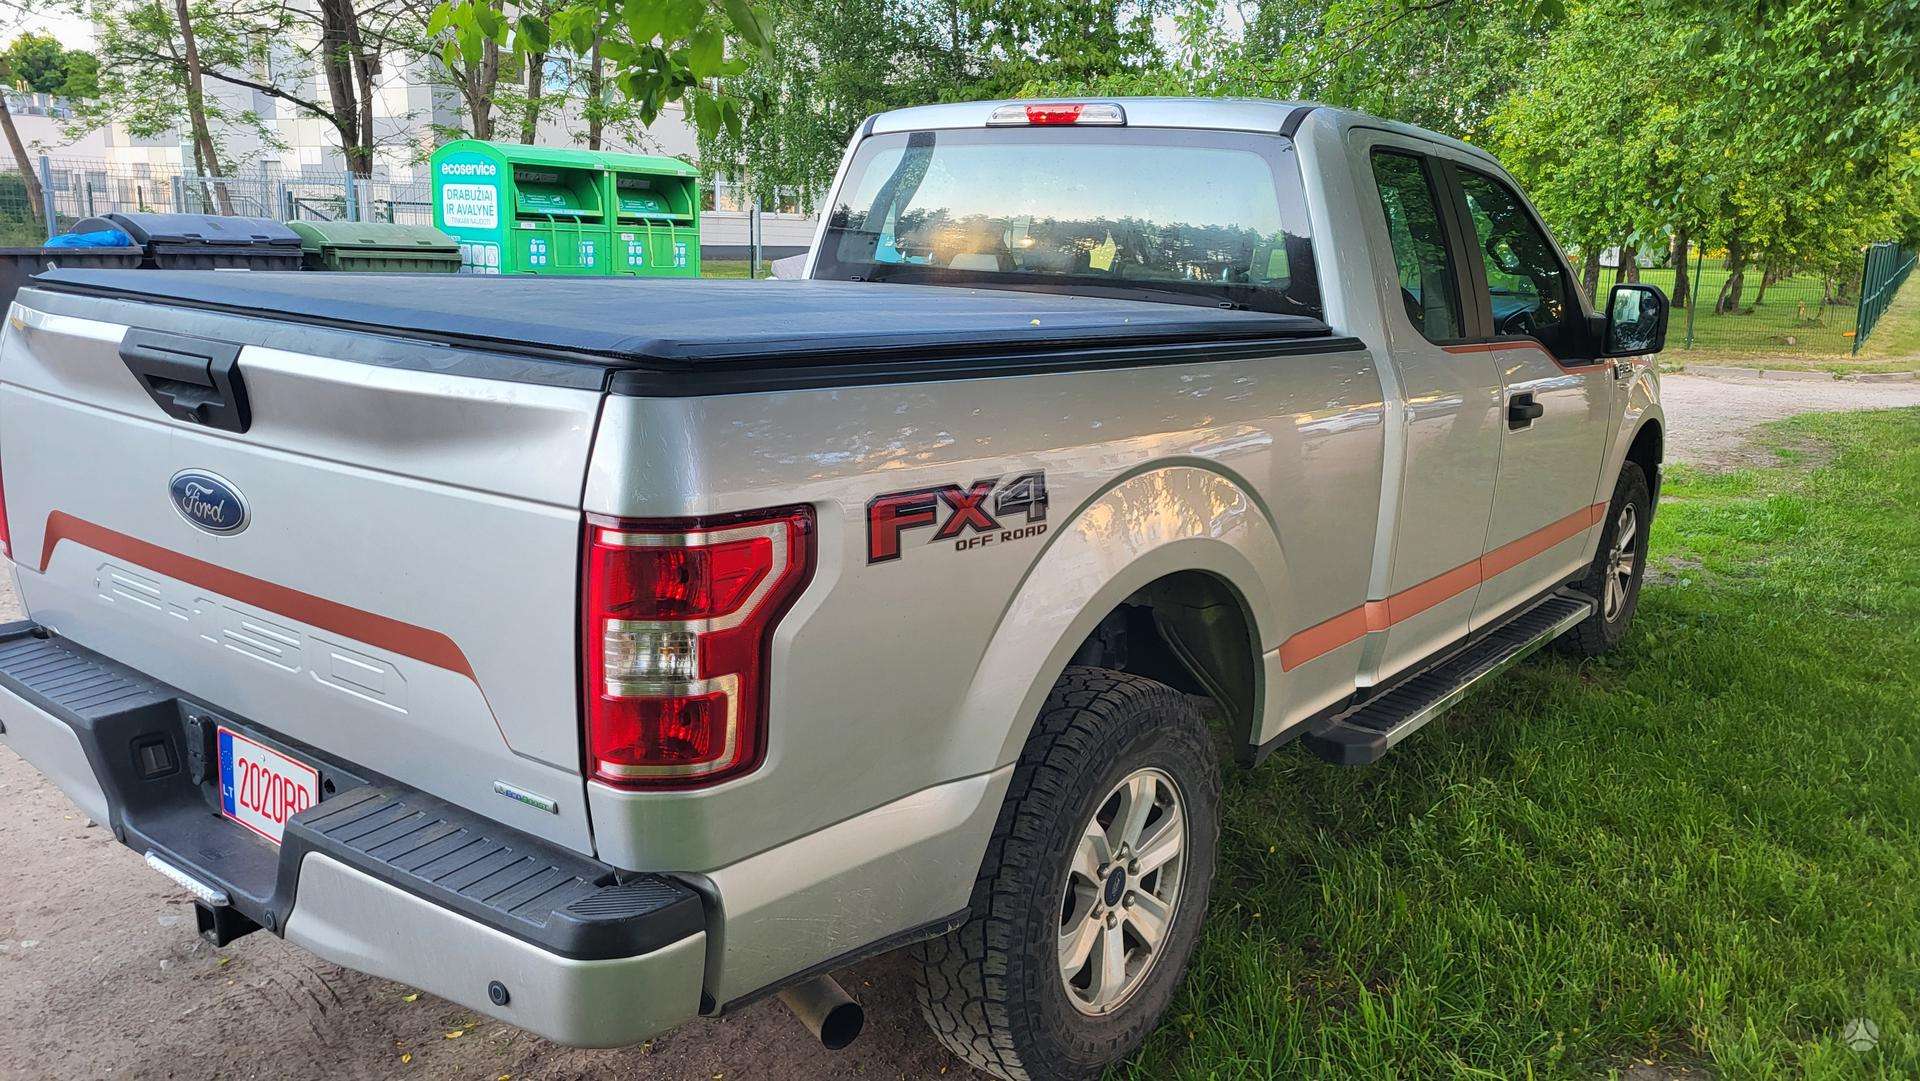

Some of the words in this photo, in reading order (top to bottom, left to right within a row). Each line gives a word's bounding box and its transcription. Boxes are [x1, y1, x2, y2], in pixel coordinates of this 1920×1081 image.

[441, 161, 496, 175] ecoservice
[446, 187, 493, 201] DRABUŽIAI
[446, 203, 455, 213] IR
[457, 203, 495, 216] AVALYNĖ
[182, 482, 225, 522] Ford
[865, 468, 1049, 566] FX4
[955, 534, 994, 551] OFF
[1001, 523, 1048, 543] ROAD
[222, 783, 234, 799] LT
